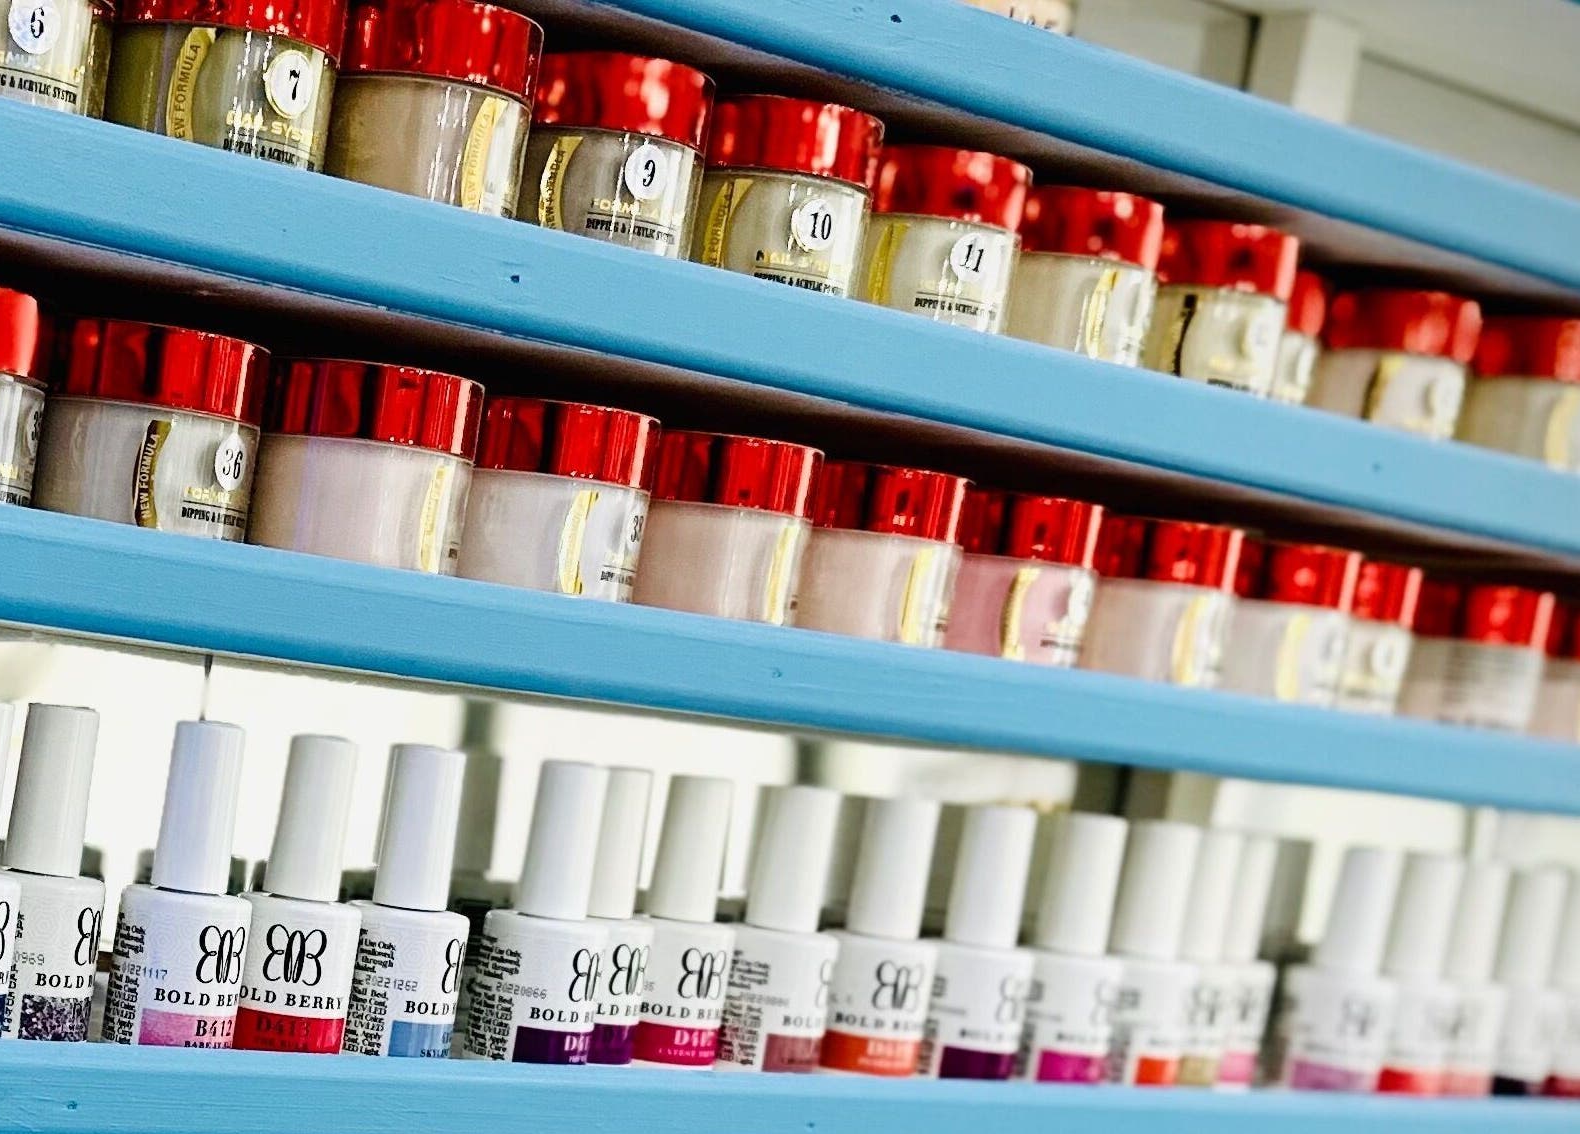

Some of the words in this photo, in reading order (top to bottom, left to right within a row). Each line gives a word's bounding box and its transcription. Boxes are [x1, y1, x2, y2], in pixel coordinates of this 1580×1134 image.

[30, 7, 45, 39] 6
[17, 77, 51, 96] ACRYLIC
[174, 43, 201, 110] FORMULA
[288, 69, 301, 100] 7
[642, 159, 657, 188] 9
[808, 210, 832, 240] 10
[963, 242, 986, 274] 11
[139, 433, 160, 491] FORMULA
[222, 449, 243, 481] 36
[140, 492, 149, 520] NEW
[35, 972, 86, 989] BOLD
[154, 987, 210, 1008] BOLD
[405, 1000, 448, 1017] BOLD
[641, 1001, 691, 1020] BOLD
[195, 1018, 232, 1039] B412
[529, 1006, 580, 1024] BOLD
